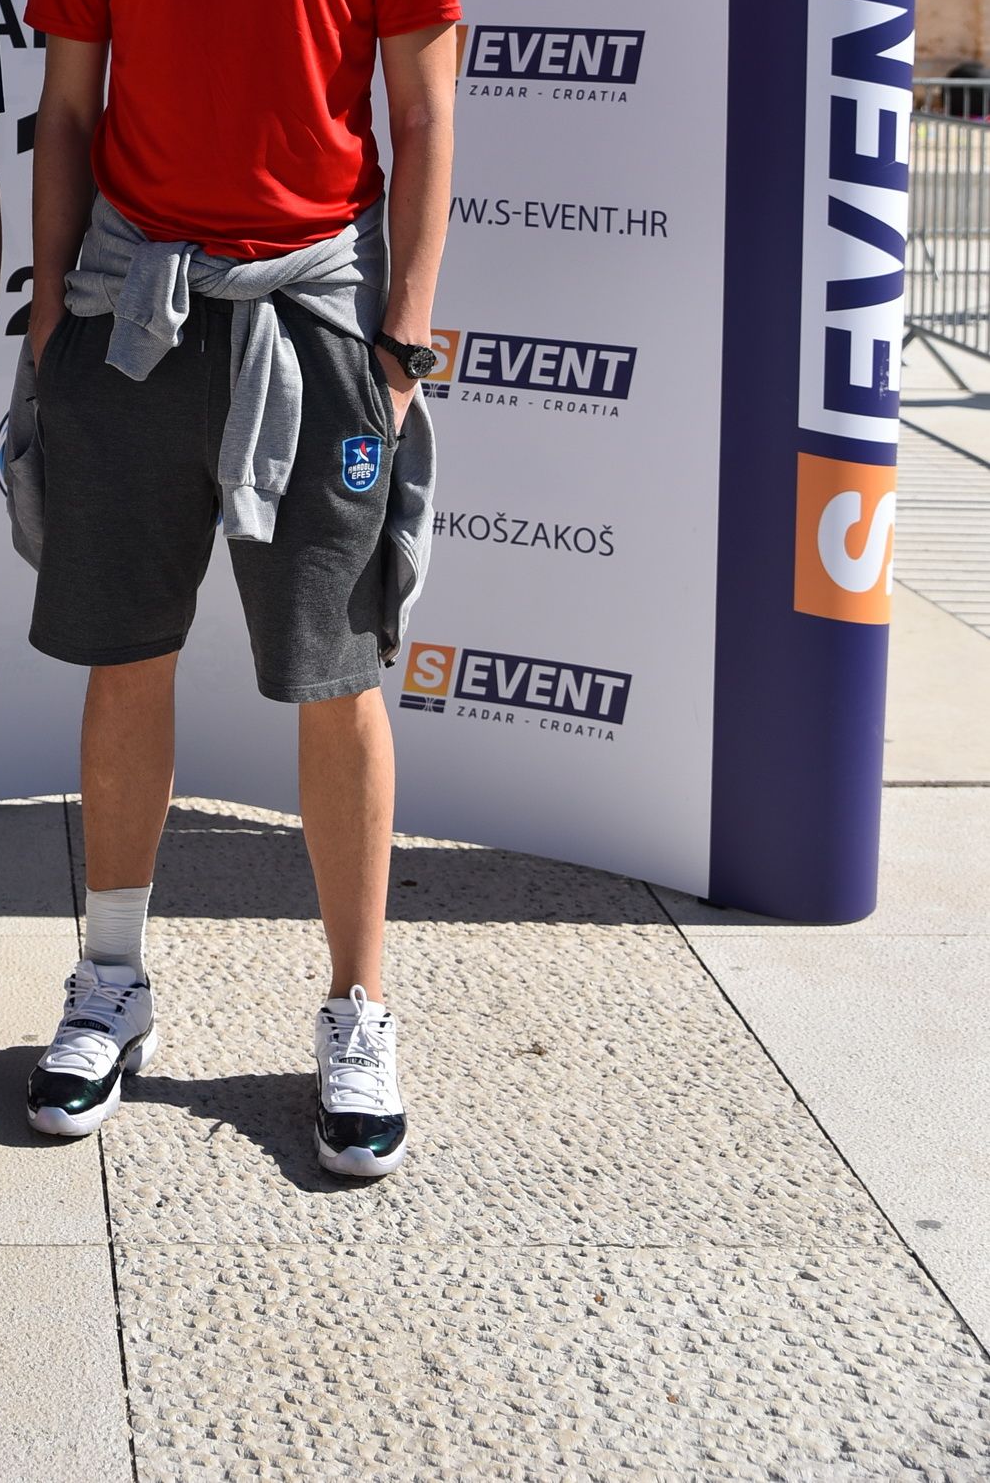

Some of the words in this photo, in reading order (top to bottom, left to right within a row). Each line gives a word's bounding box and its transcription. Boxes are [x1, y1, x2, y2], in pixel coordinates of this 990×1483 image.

[473, 31, 638, 77] EVENT
[469, 85, 527, 98] ZADAR
[552, 88, 628, 103] CROATIA
[448, 197, 668, 238] W.S-EVENT.HR
[465, 338, 630, 391] EVENT
[461, 390, 518, 406] ZADAR
[543, 399, 619, 417] CROATIA
[351, 470, 371, 480] EFES
[433, 511, 614, 557] #KOŠZAKOŠ
[461, 655, 625, 716] EVENT
[457, 706, 514, 724] ZADAR
[540, 718, 614, 741] CROATIA
